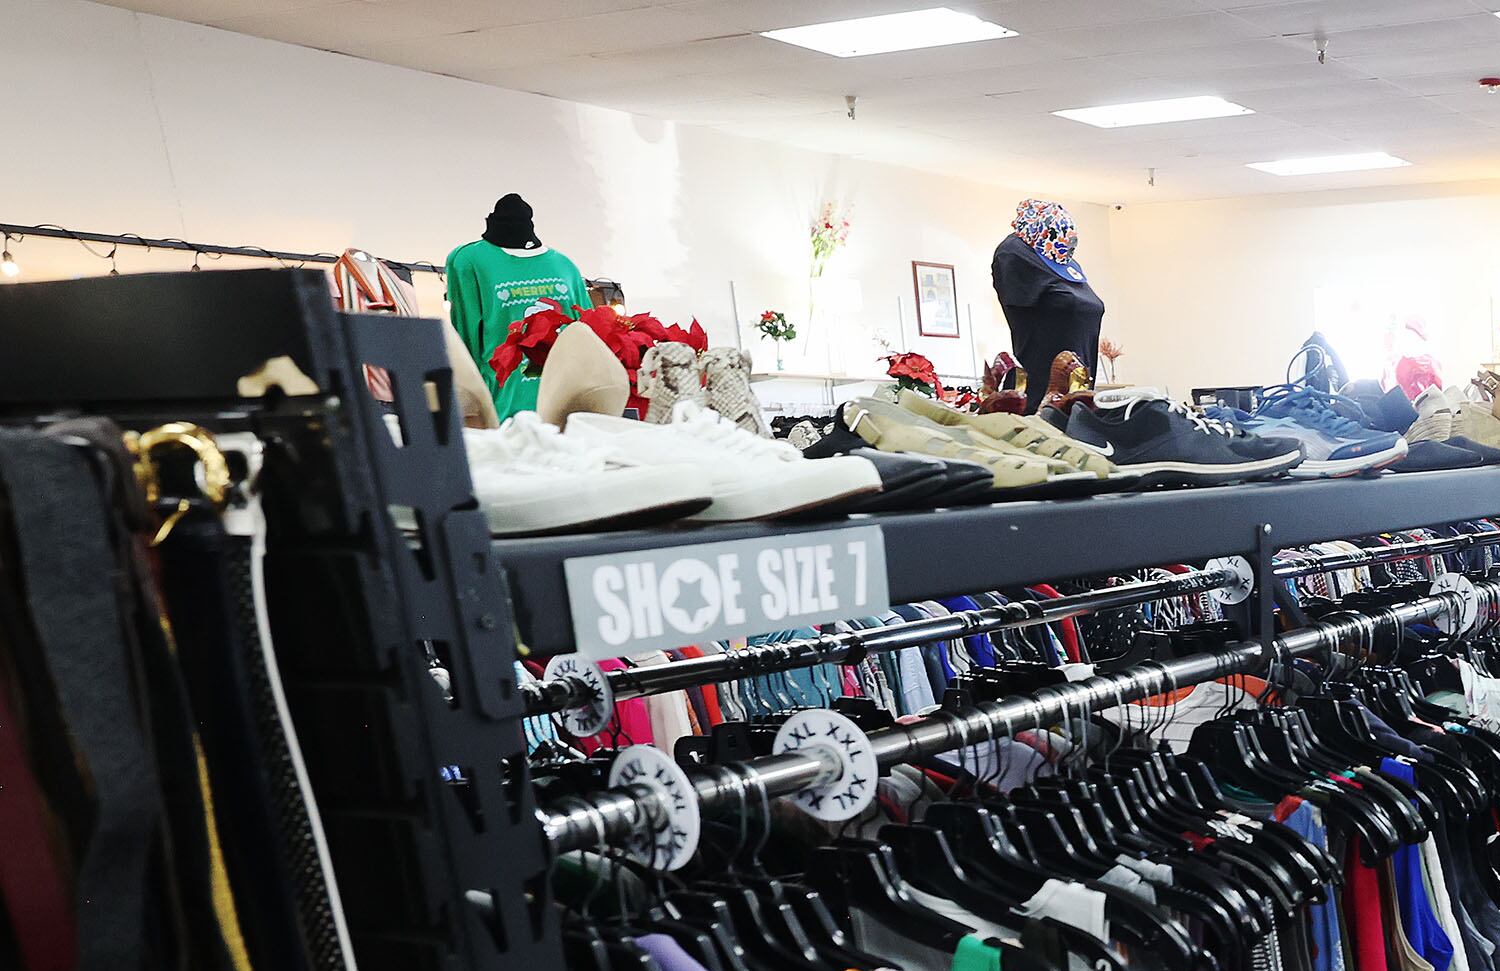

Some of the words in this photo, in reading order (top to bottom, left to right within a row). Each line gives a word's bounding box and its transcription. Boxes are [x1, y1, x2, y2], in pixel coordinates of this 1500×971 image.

[511, 284, 555, 297] MERRY
[1227, 557, 1239, 568] XL
[592, 553, 746, 645] SHOE
[757, 544, 839, 621] SIZE
[847, 540, 867, 606] 7
[825, 722, 862, 763] XXL
[655, 764, 686, 812] XXXL
[832, 774, 867, 811] XXL
